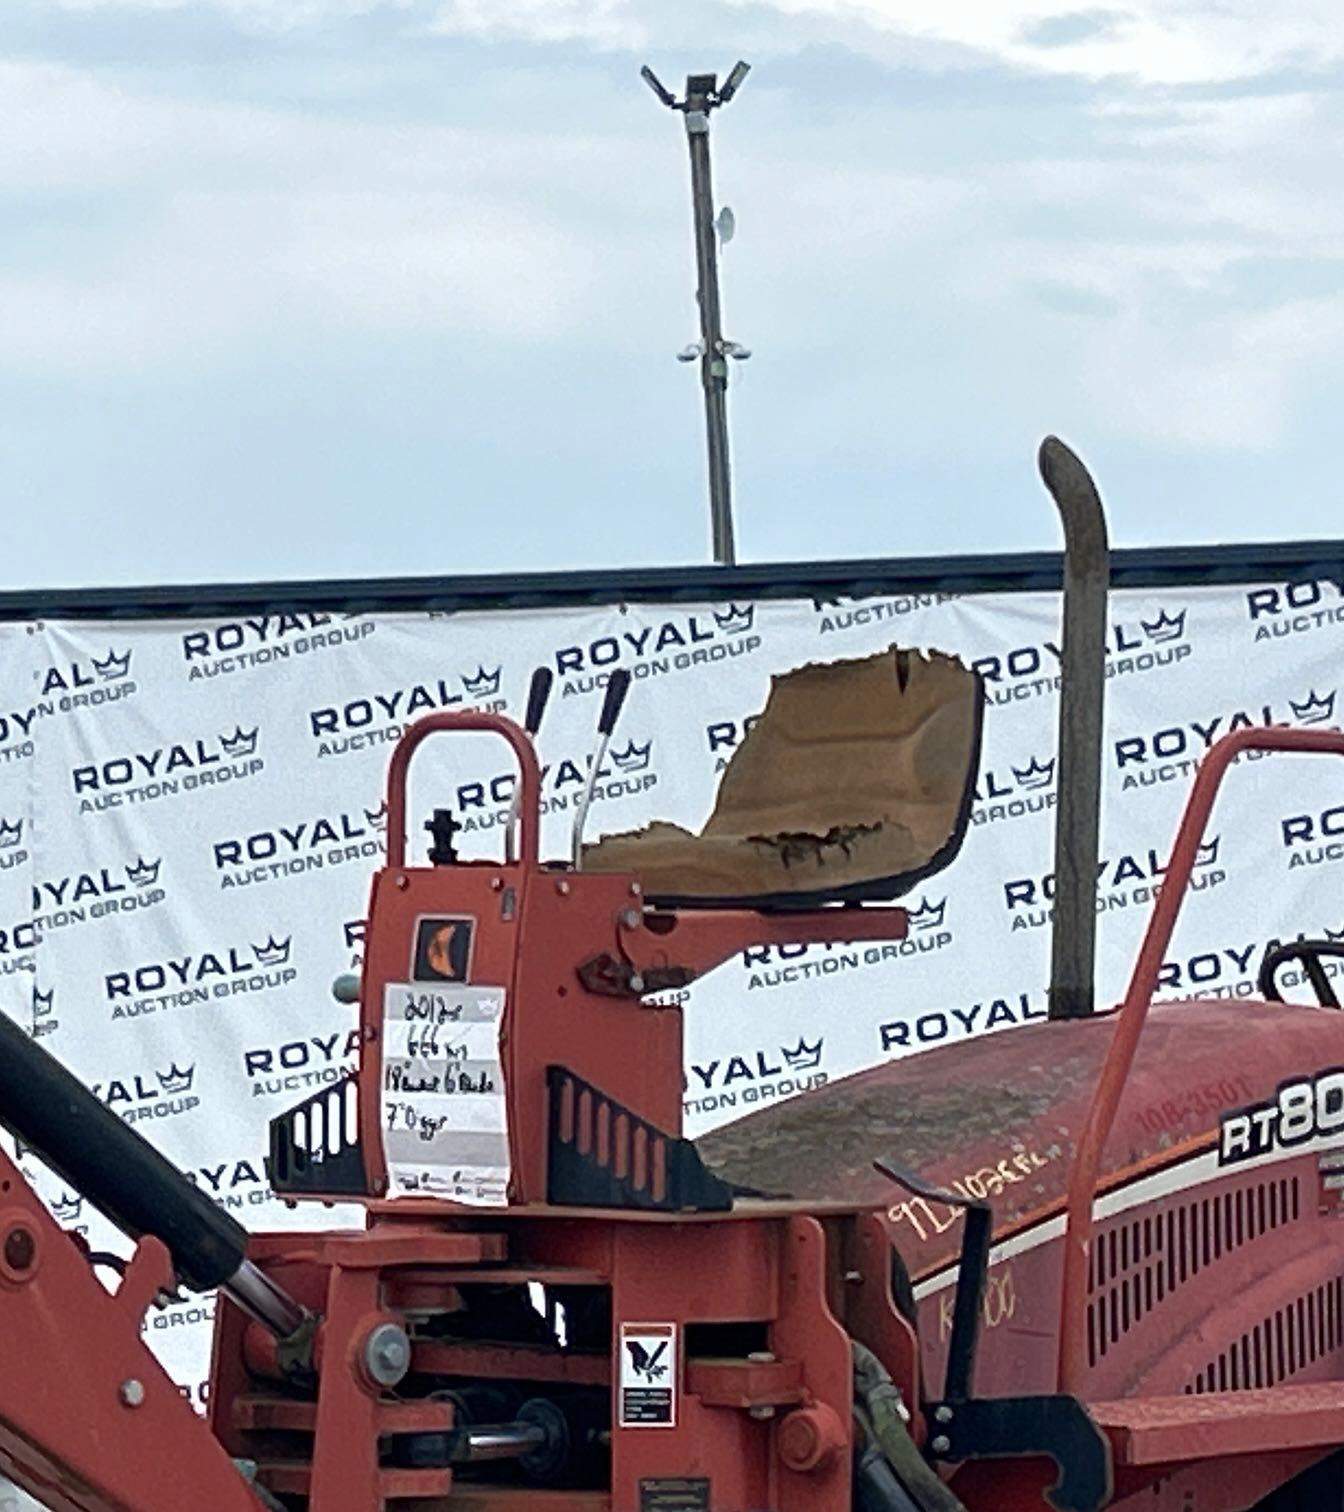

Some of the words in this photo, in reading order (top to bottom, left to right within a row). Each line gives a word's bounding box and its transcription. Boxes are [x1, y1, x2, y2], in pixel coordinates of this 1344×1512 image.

[188, 644, 289, 682] AUCTION
[295, 621, 375, 653] GROUP
[556, 617, 714, 675] ROYAL
[675, 635, 761, 669] GROUP
[59, 680, 136, 711] GROUP
[311, 680, 463, 736] ROYAL
[73, 740, 220, 794] ROYAL
[79, 780, 178, 816] AUCTION
[184, 758, 262, 789] GROUP
[216, 814, 365, 868] ROYAL
[221, 854, 322, 890] AUCTION
[328, 837, 392, 864] GROU
[90, 887, 167, 917] GROUP
[105, 948, 252, 1000] ROYAL
[747, 953, 857, 991] AUCTION
[864, 931, 952, 964] GROUP
[110, 987, 209, 1022] AUCTION
[215, 966, 294, 996] GROUP
